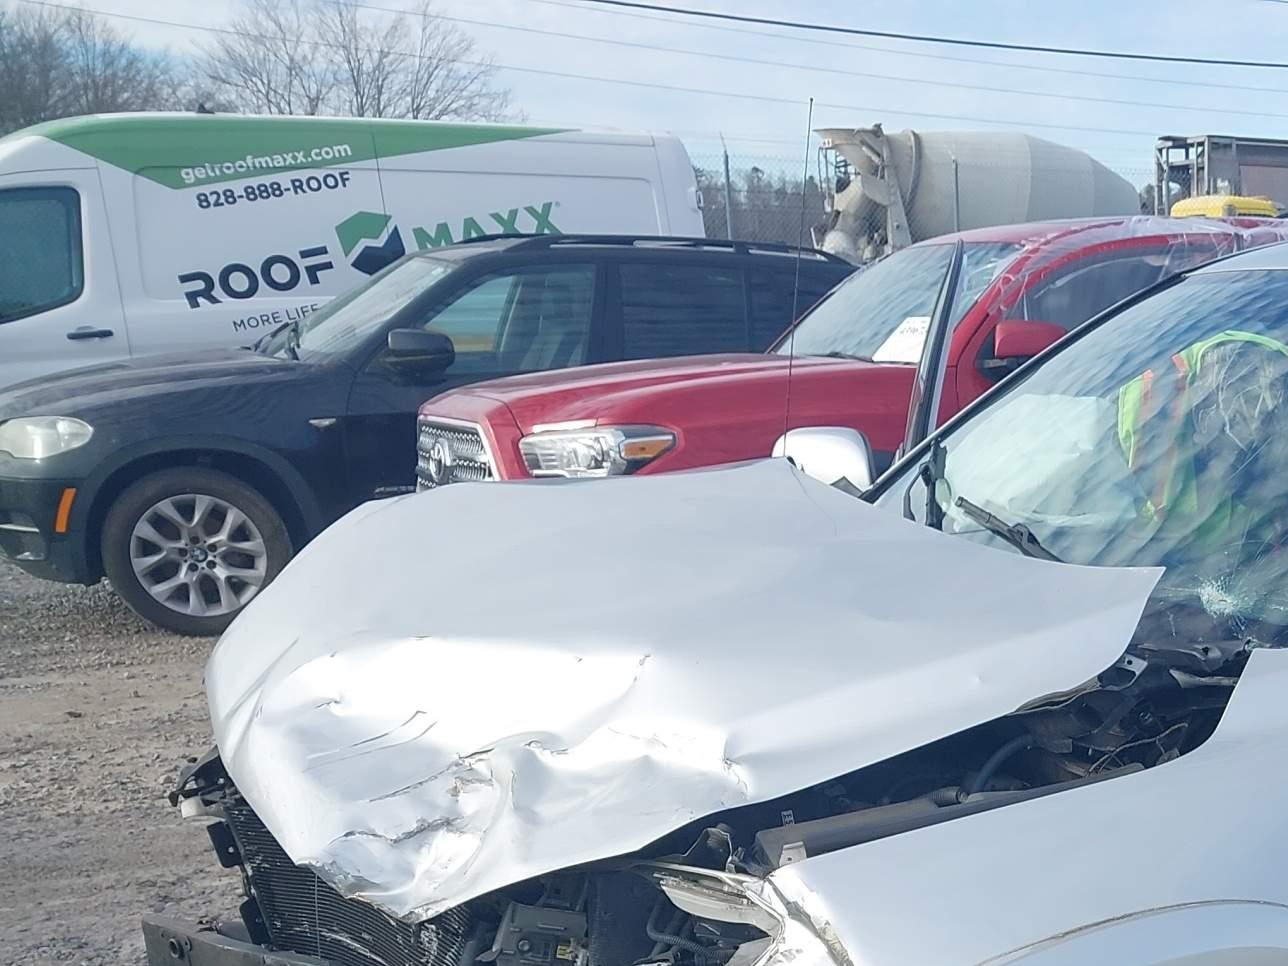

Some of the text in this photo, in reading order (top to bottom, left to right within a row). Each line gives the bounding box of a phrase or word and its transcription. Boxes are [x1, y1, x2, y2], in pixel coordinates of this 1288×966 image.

[181, 143, 352, 184] getroofmaxx.com
[196, 171, 351, 209] 828-888-ROOF
[178, 202, 563, 309] ROOF MAXX
[233, 311, 282, 332] MORE
